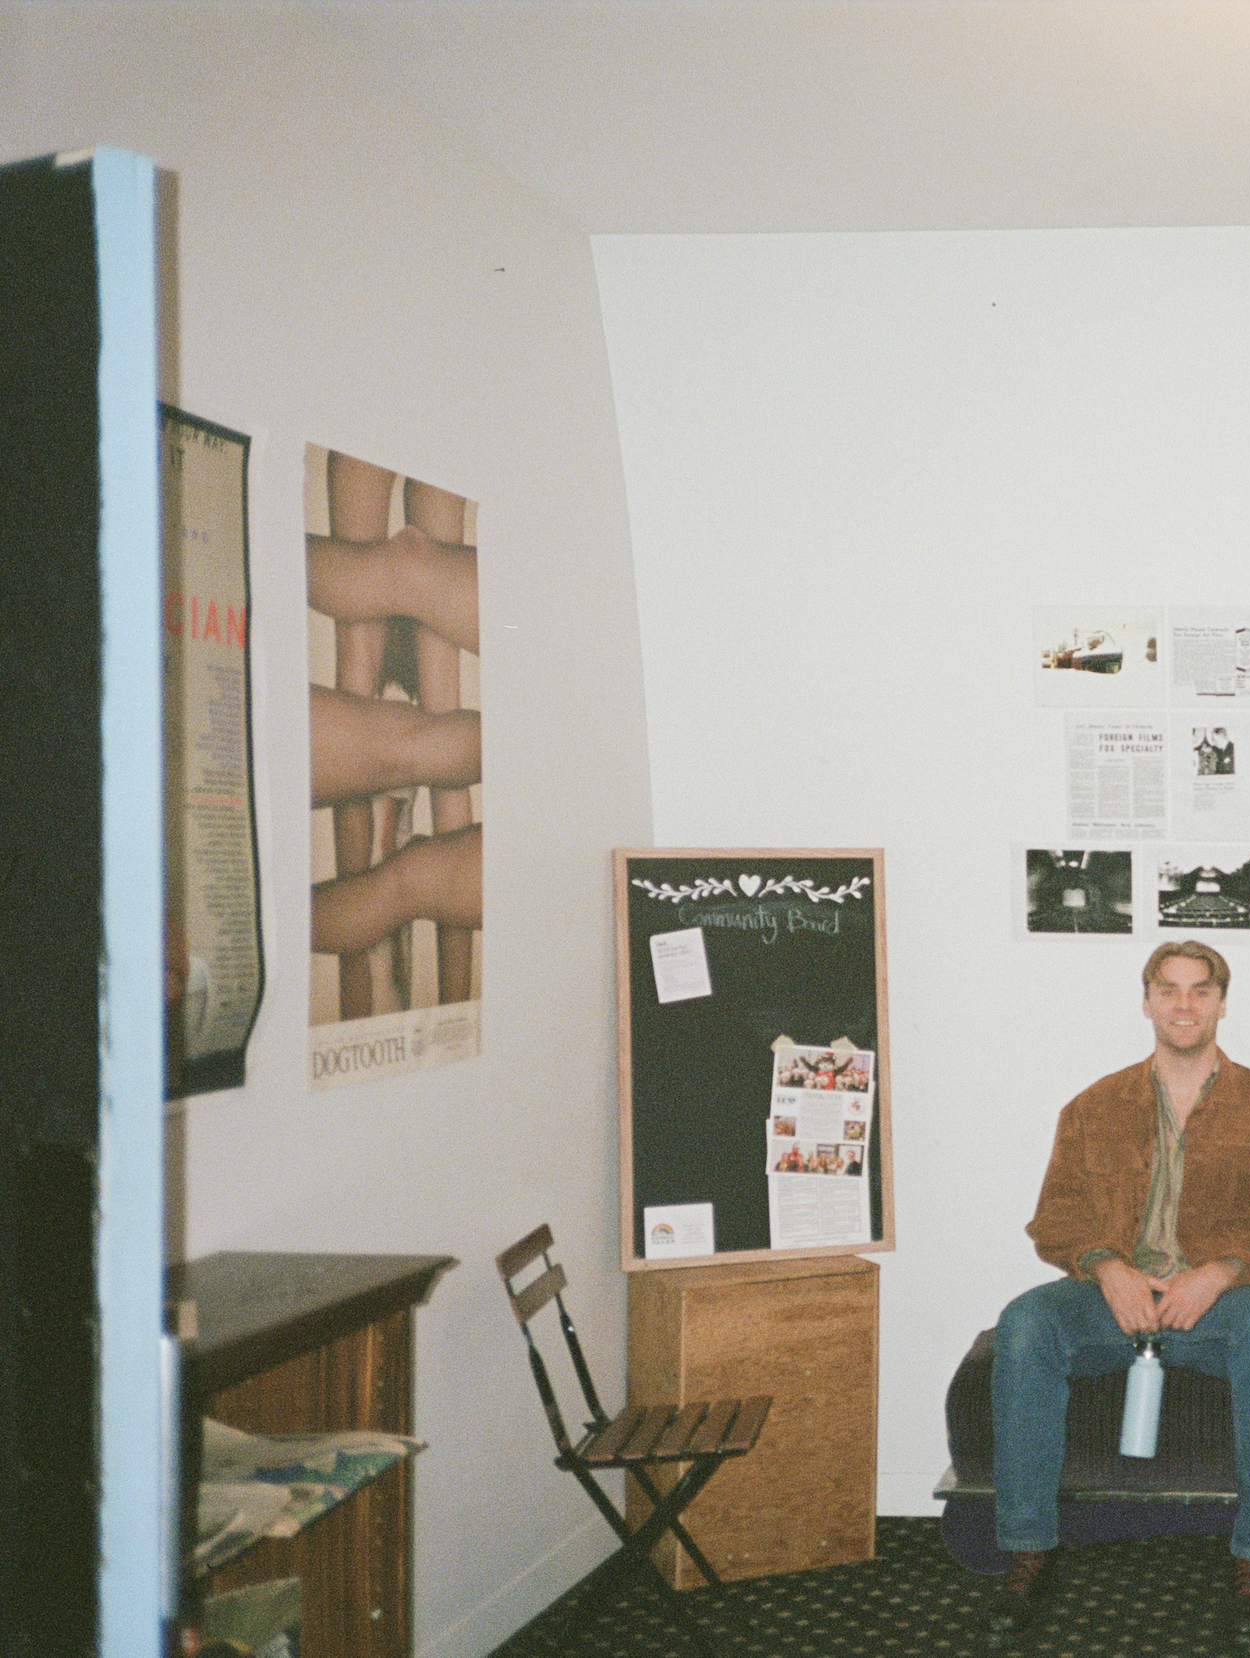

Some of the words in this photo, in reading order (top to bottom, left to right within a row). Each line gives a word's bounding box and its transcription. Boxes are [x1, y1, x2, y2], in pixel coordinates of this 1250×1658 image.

[1098, 733, 1134, 741] FOREIGN
[1138, 733, 1163, 741] FILMS
[1098, 744, 1115, 752] FOX
[1120, 744, 1163, 752] SPECIALTY
[312, 1036, 407, 1080] DOGTOOTH
